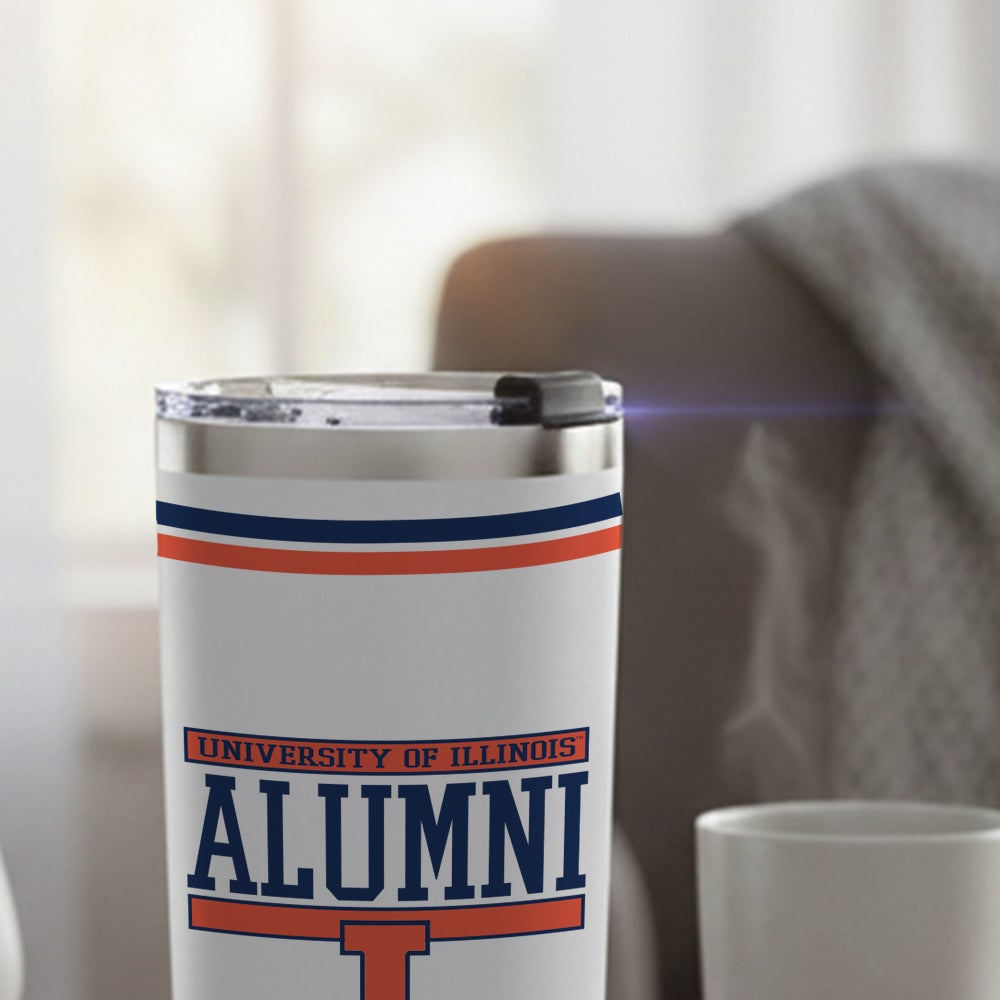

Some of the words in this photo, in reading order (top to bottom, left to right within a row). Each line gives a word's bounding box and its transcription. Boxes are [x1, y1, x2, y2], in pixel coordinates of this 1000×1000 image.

[197, 736, 392, 769] UNIVERSITY
[403, 748, 438, 769] OF
[187, 770, 589, 902] ALUMNI
